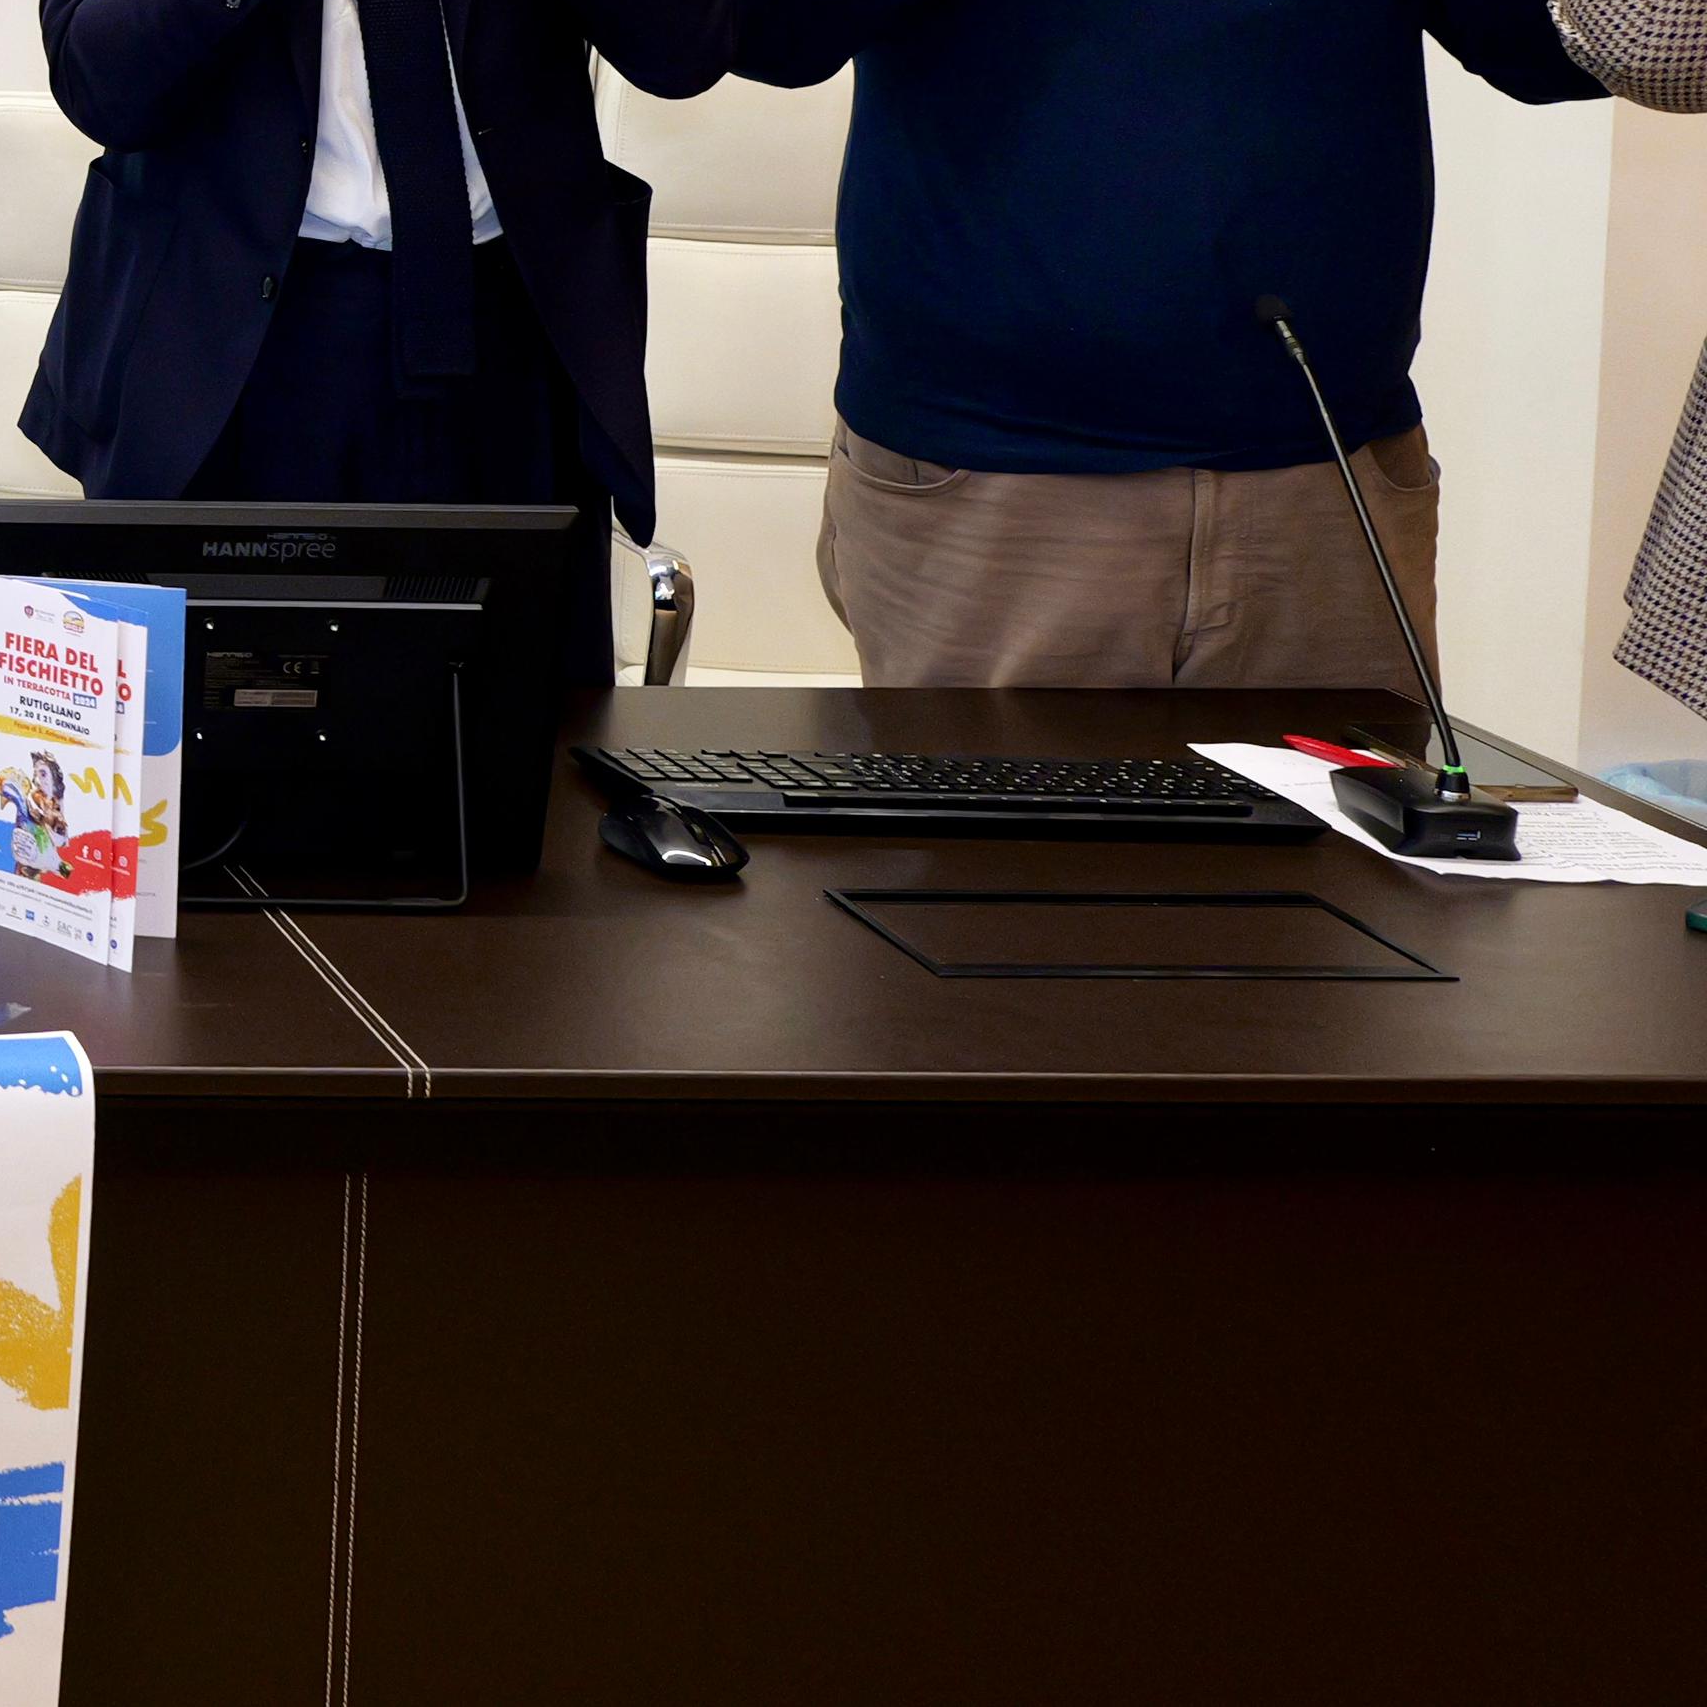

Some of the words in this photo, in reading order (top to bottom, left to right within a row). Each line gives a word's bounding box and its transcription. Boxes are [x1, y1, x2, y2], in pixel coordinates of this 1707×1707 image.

[4, 631, 60, 663] FIERA
[65, 646, 99, 674] DEL
[3, 675, 14, 686] IN
[16, 678, 71, 701] TERRACOTTA
[19, 695, 82, 721] RUTIGLIANO
[24, 709, 35, 720] 20
[55, 718, 90, 736] GENNAIO
